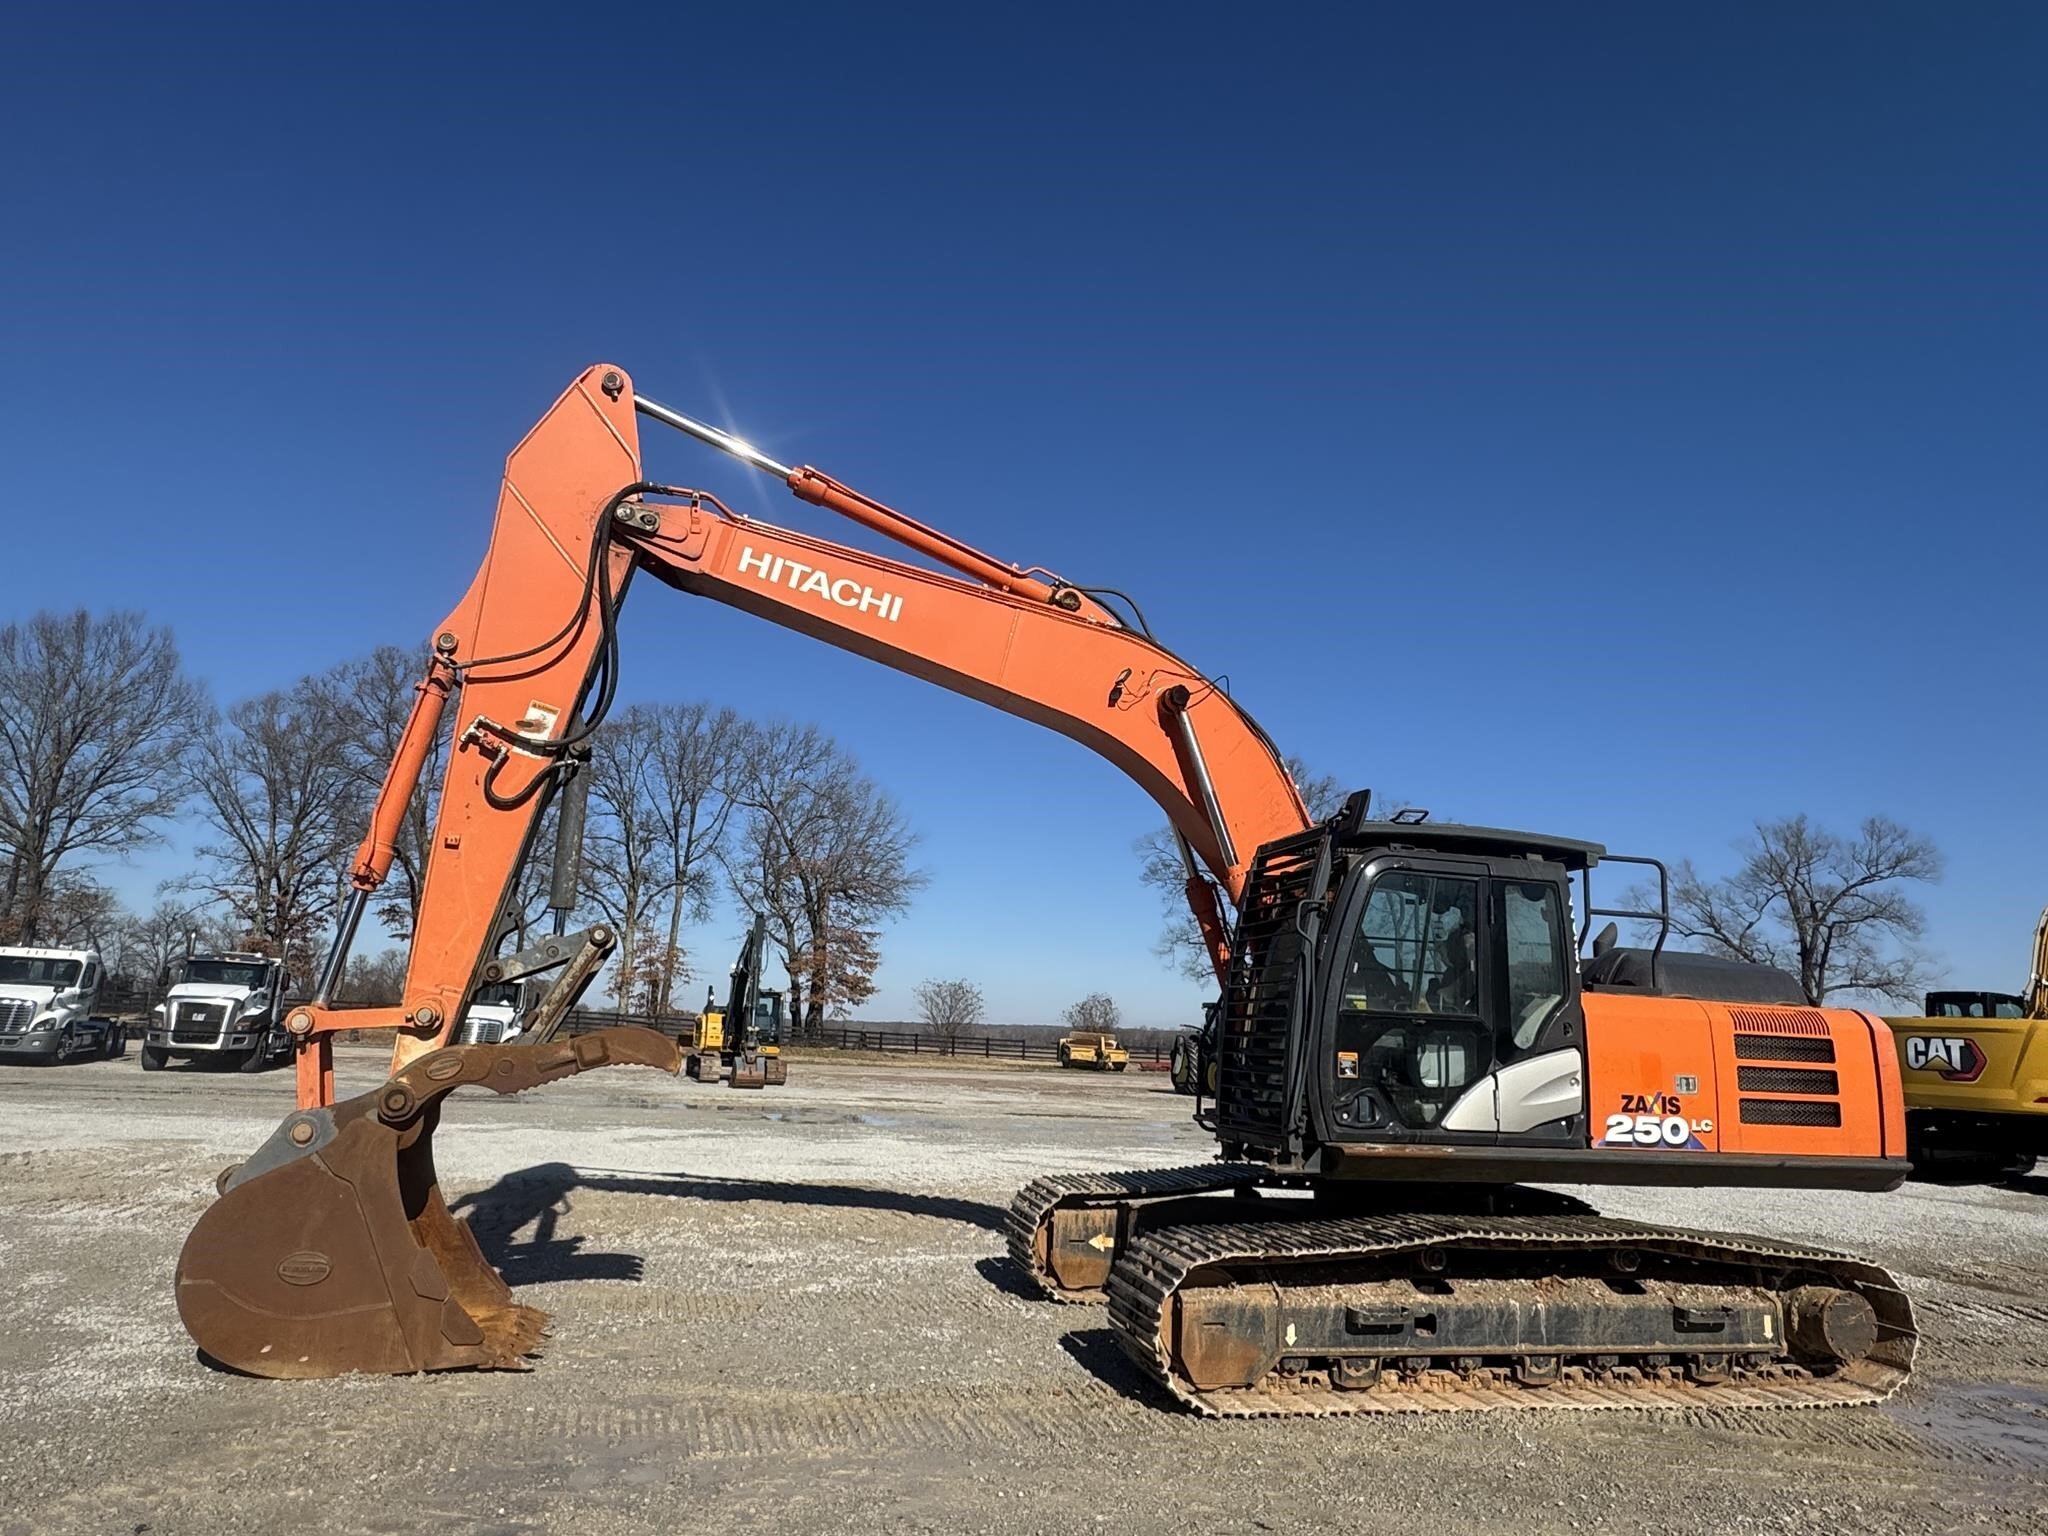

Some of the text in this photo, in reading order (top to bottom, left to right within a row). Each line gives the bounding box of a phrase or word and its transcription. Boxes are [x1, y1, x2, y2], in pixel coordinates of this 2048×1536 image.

[737, 546, 904, 622] HITACHI
[1906, 1037, 1965, 1071] CAT
[1621, 1091, 1682, 1115] ZAXIS
[1605, 1114, 1690, 1147] 250
